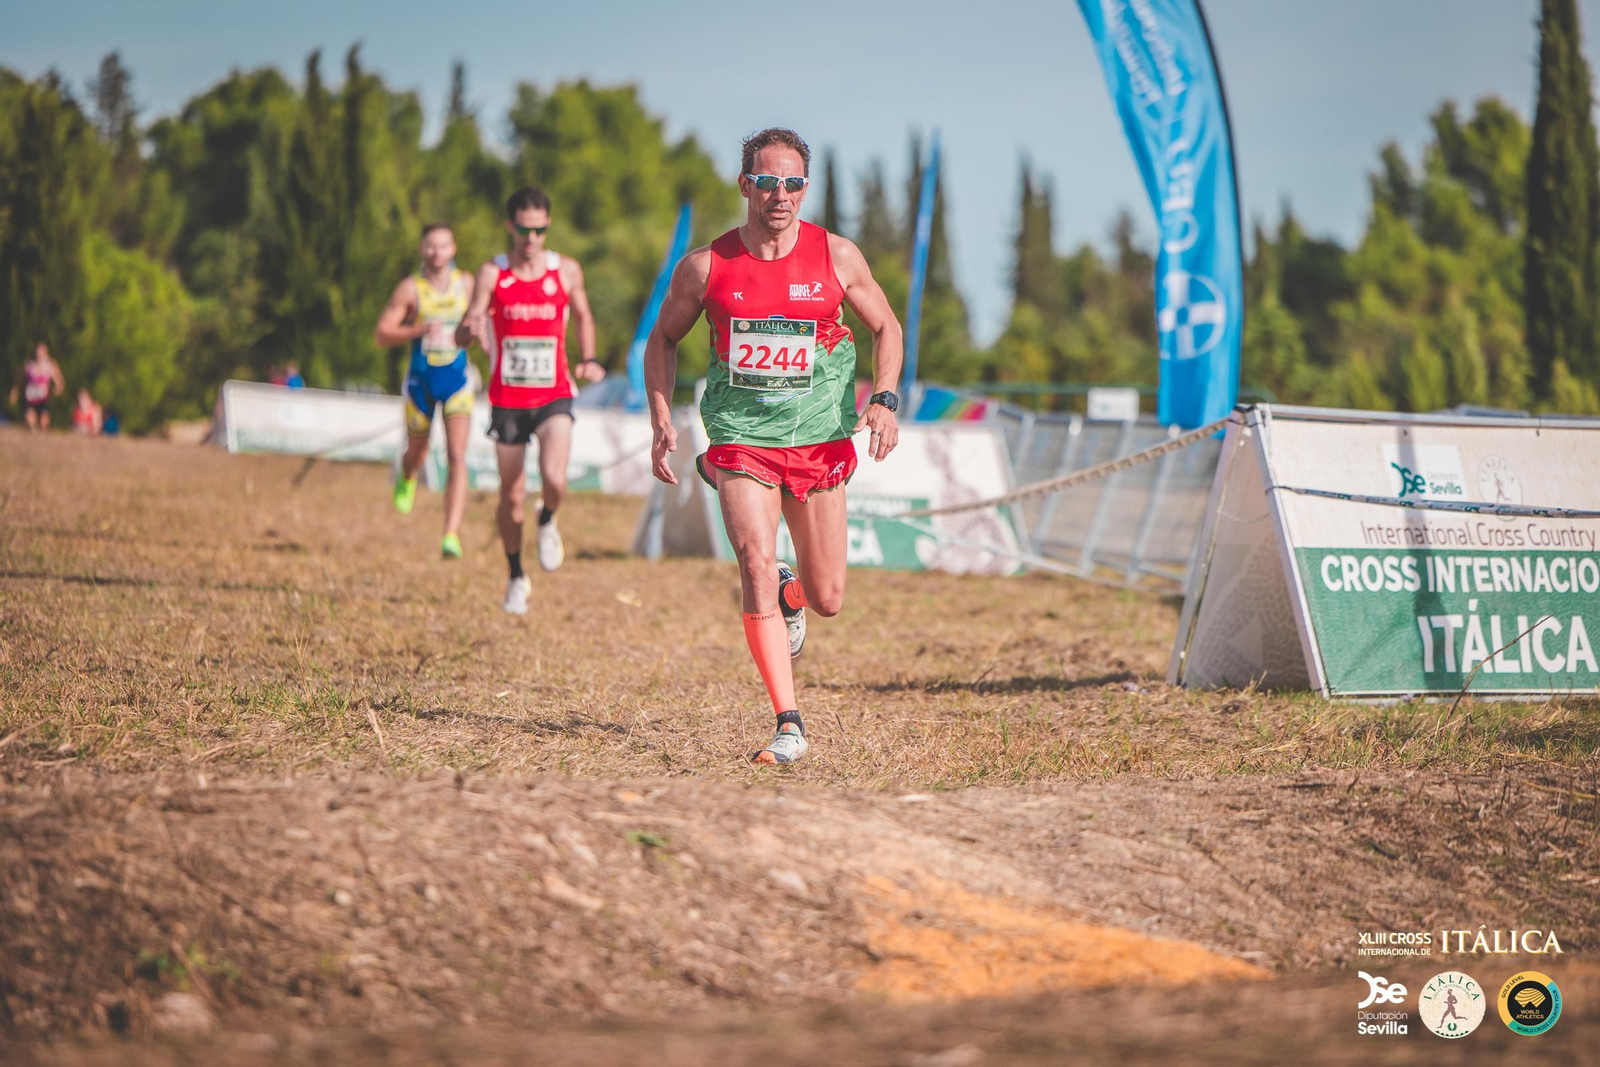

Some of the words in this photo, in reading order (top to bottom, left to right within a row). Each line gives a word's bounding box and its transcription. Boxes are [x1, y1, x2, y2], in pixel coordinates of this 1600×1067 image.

[755, 320, 795, 331] ITÁLICA
[737, 343, 809, 372] 2244
[1429, 481, 1462, 496] Sevilla
[1360, 521, 1475, 546] International
[1475, 522, 1525, 547] Cross
[1527, 523, 1596, 553] Country
[1320, 555, 1421, 593] CROSS
[1425, 556, 1600, 594] INTERNACIO
[1416, 598, 1600, 673] ITÁLICA
